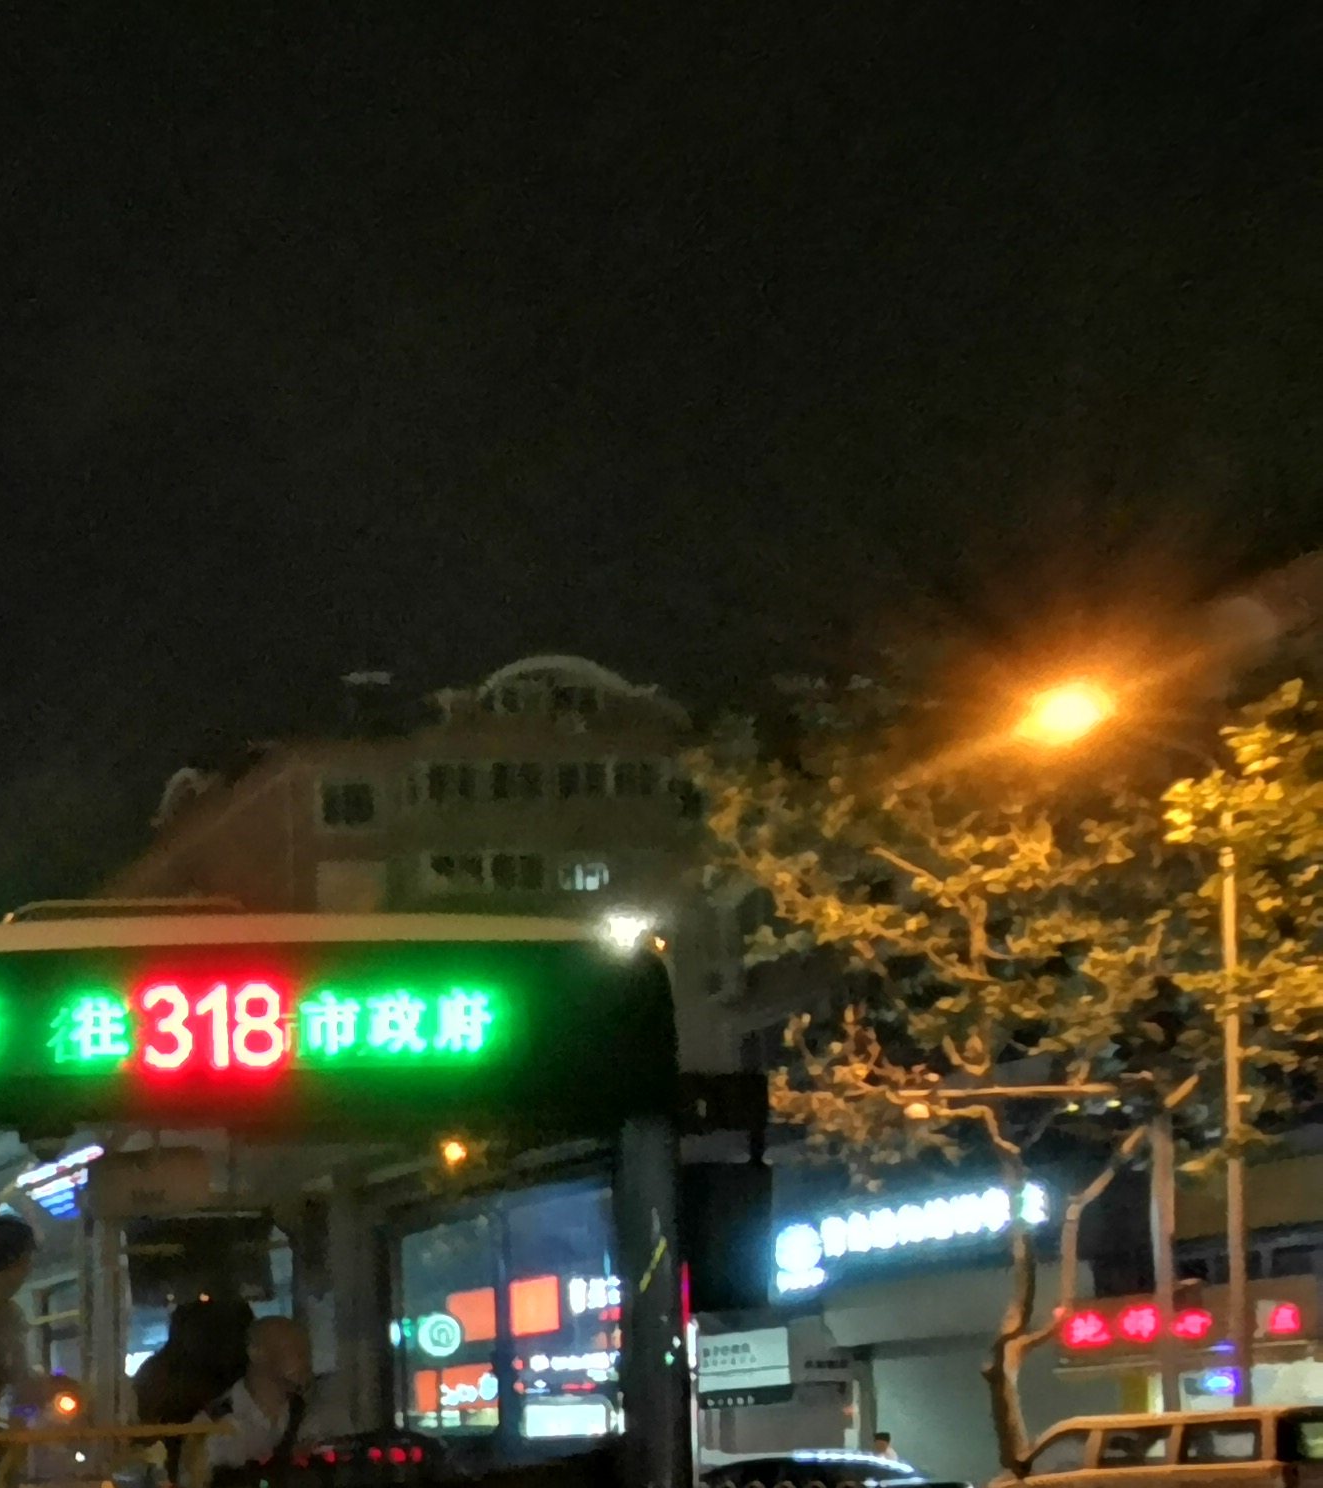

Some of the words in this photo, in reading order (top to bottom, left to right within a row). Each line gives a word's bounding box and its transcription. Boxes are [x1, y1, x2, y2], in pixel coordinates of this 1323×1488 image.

[143, 983, 283, 1069] 318
[299, 989, 494, 1056] 市政府
